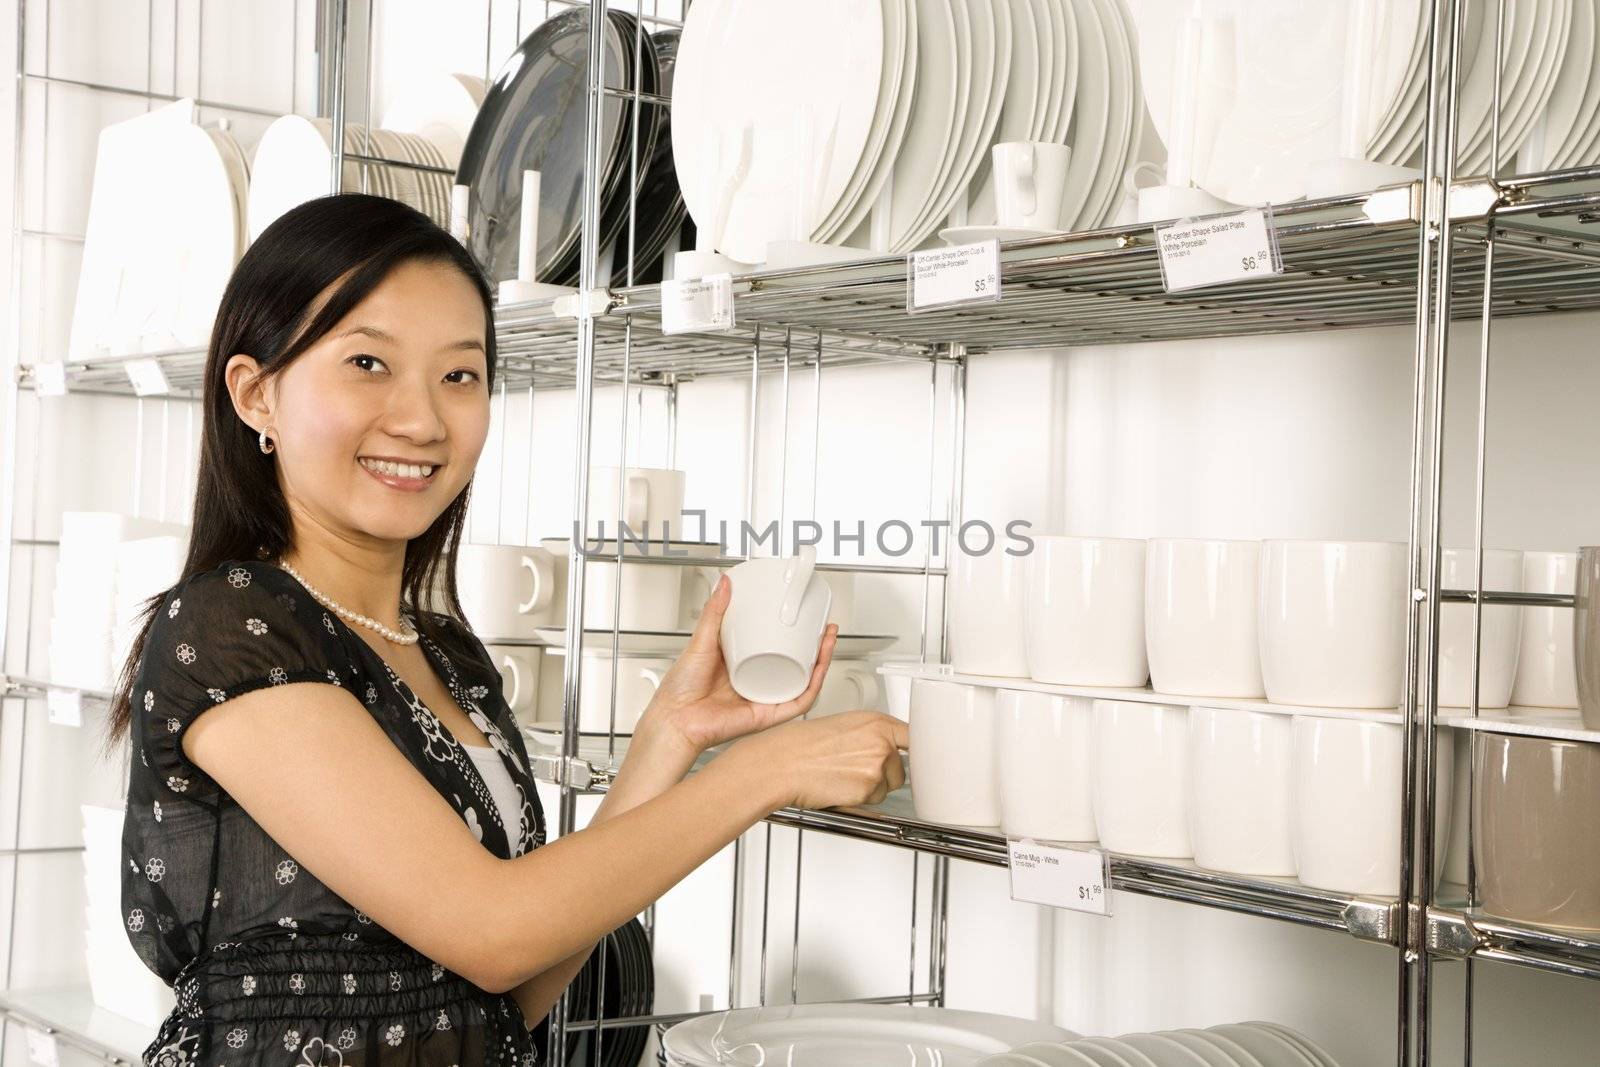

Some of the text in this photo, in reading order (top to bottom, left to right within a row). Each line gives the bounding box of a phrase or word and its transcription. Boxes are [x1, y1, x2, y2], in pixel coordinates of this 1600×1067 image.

[1192, 228, 1211, 237] Shape
[1211, 224, 1229, 234] Salad
[1229, 221, 1245, 231] Plate
[942, 252, 956, 260] Shape
[970, 247, 981, 256] Cup
[1242, 250, 1267, 271] $6.99
[974, 273, 996, 292] $5.99
[1029, 853, 1041, 864] Mug
[1044, 855, 1060, 866] White
[1078, 884, 1102, 901] $1.99
